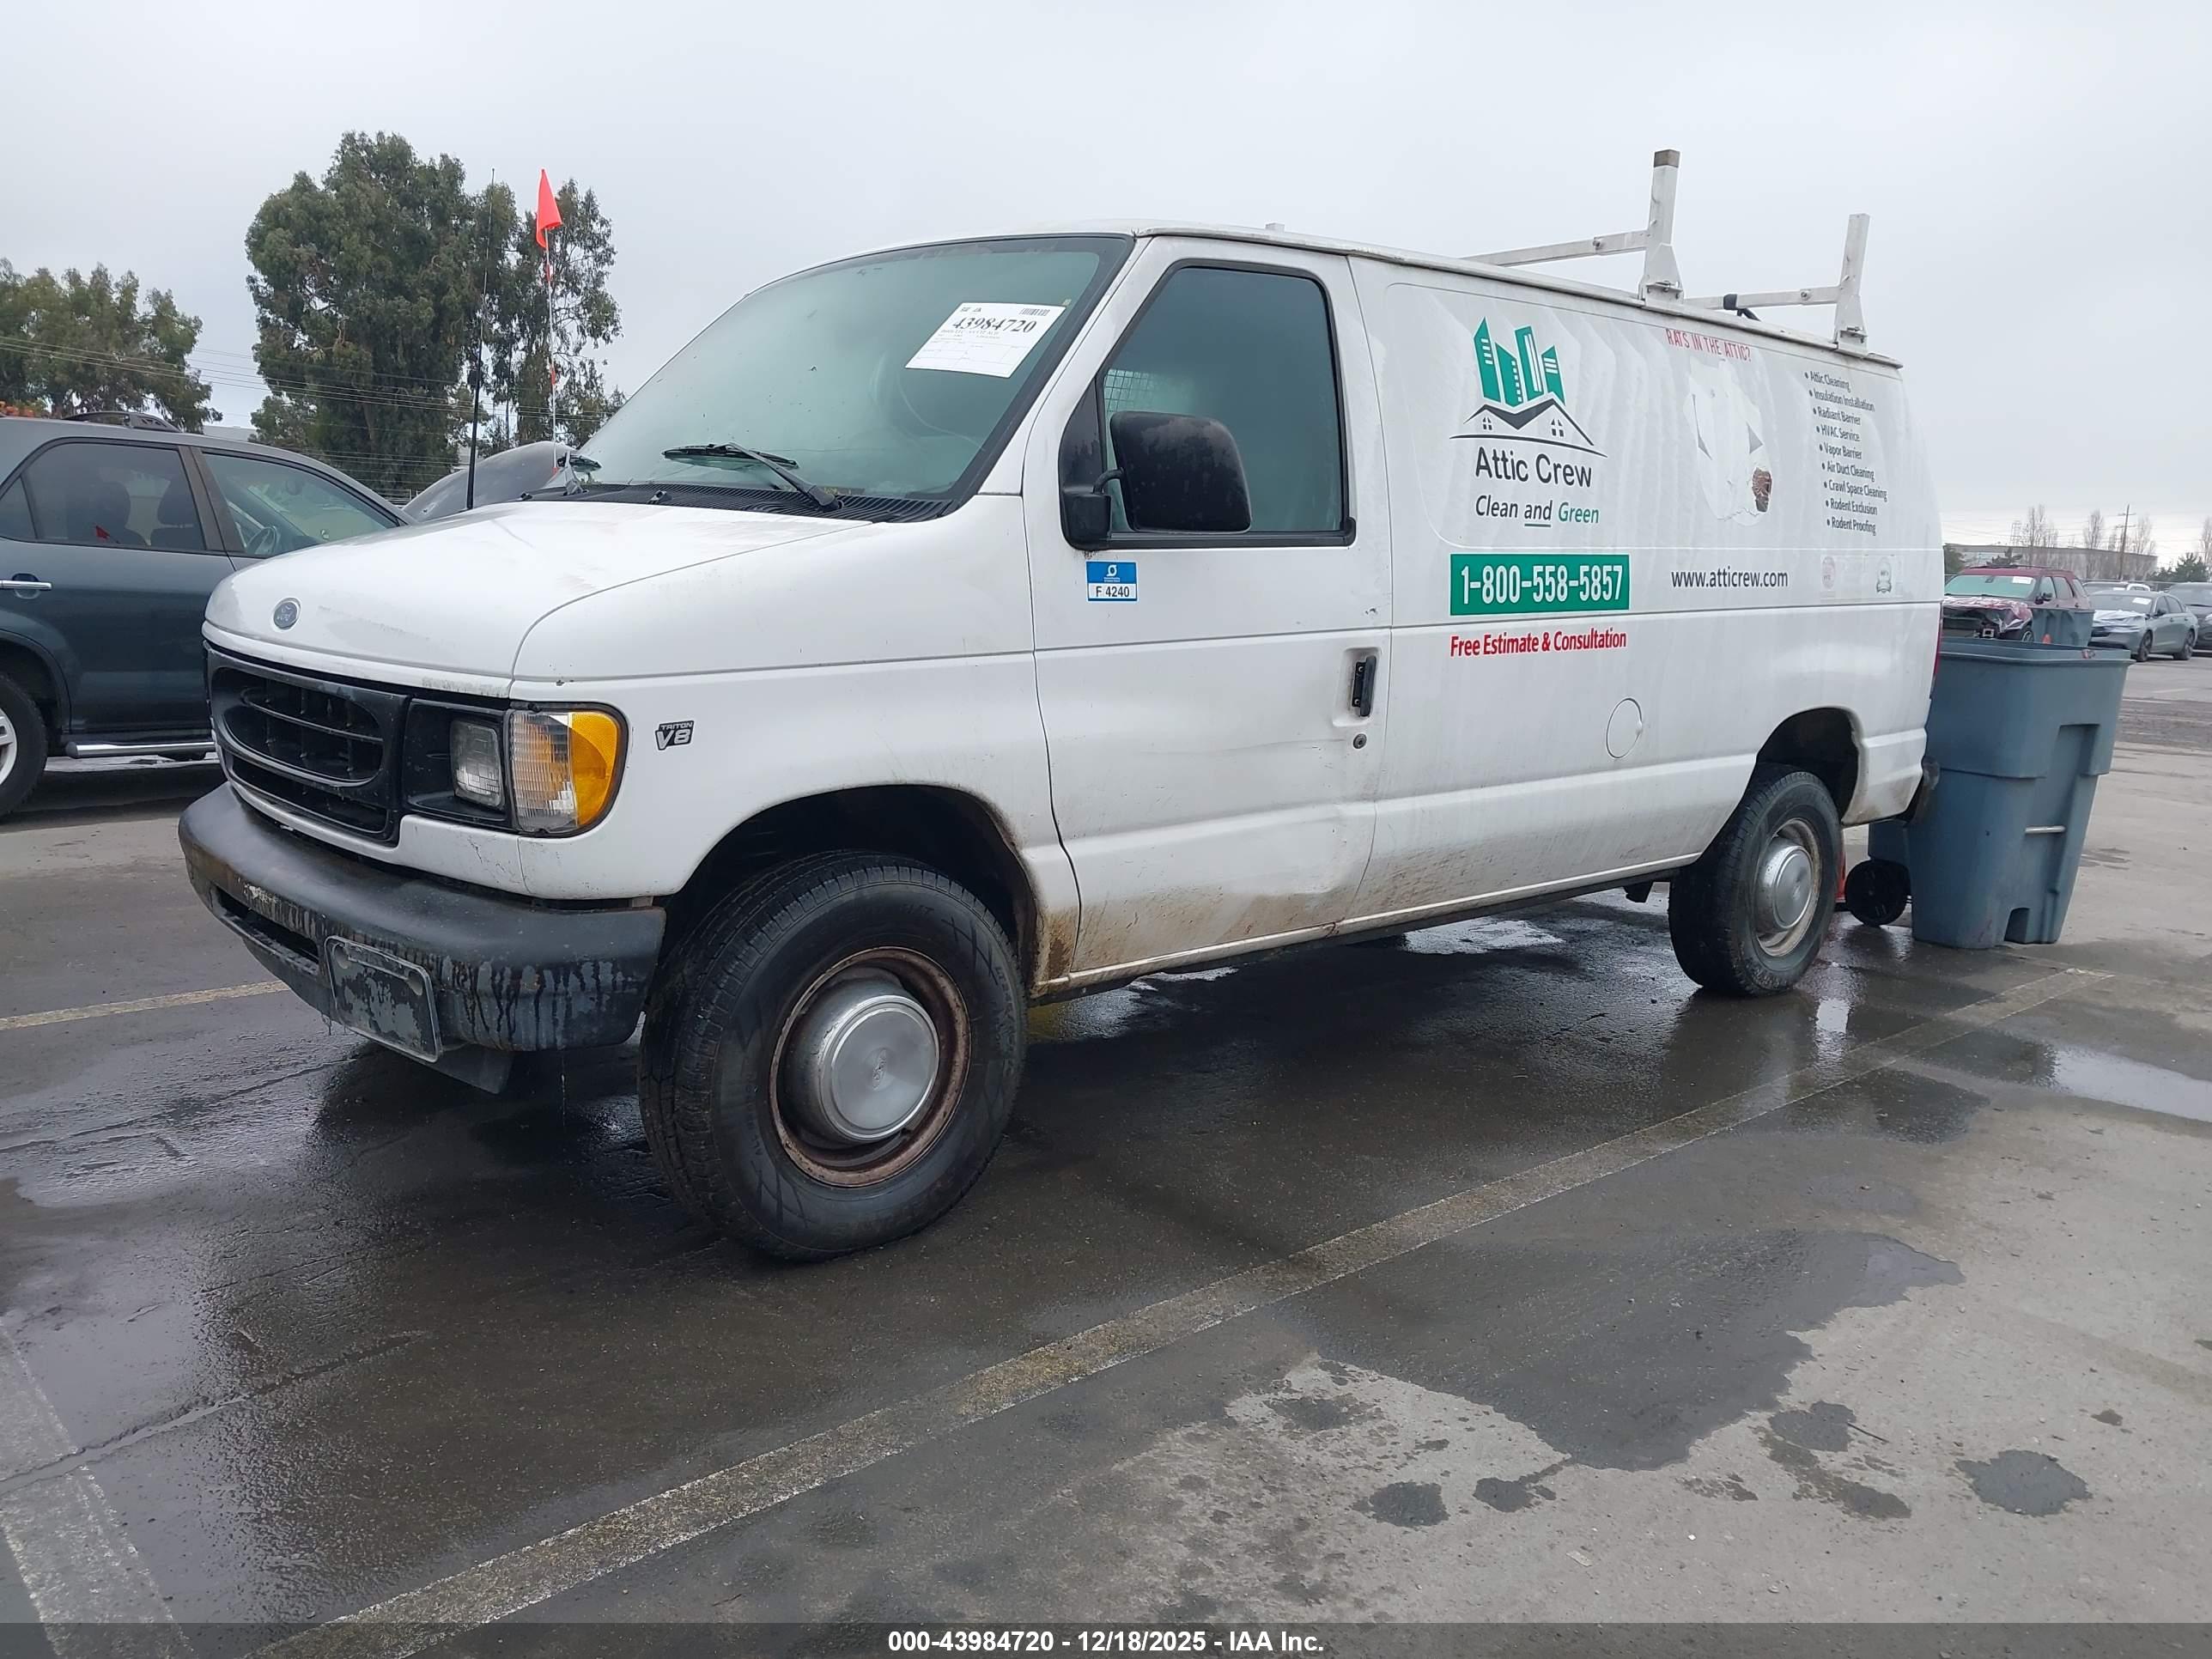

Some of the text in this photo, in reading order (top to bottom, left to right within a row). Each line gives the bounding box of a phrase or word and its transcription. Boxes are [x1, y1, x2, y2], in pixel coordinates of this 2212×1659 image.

[953, 316, 1037, 333] 43984720
[1666, 328, 1752, 362] RATS IN THE ATTIC?
[1810, 370, 1851, 393] Attic Cleaning
[1814, 388, 1875, 412] Insulation Installation
[1817, 406, 1861, 425] Radiant Barrier
[1820, 423, 1861, 442] HVAC Service
[1823, 441, 1863, 460] Vapor Barrier
[1475, 447, 1592, 488] Attic Crew
[1826, 460, 1875, 483] Air Duct Cleaning
[1828, 479, 1887, 502] Crawl Space Cleaning
[1475, 495, 1600, 523] Clean and Green
[1830, 498, 1878, 515] Rodent Exclusion
[1832, 516, 1876, 537] Rodent Proofing
[1461, 565, 1623, 605] 1-800-558-5857
[1671, 566, 1789, 587] www.atticrew.com
[1096, 586, 1130, 598] F 4240
[1450, 628, 1627, 657] Free Estimate & Consultation
[656, 729, 691, 749] V8
